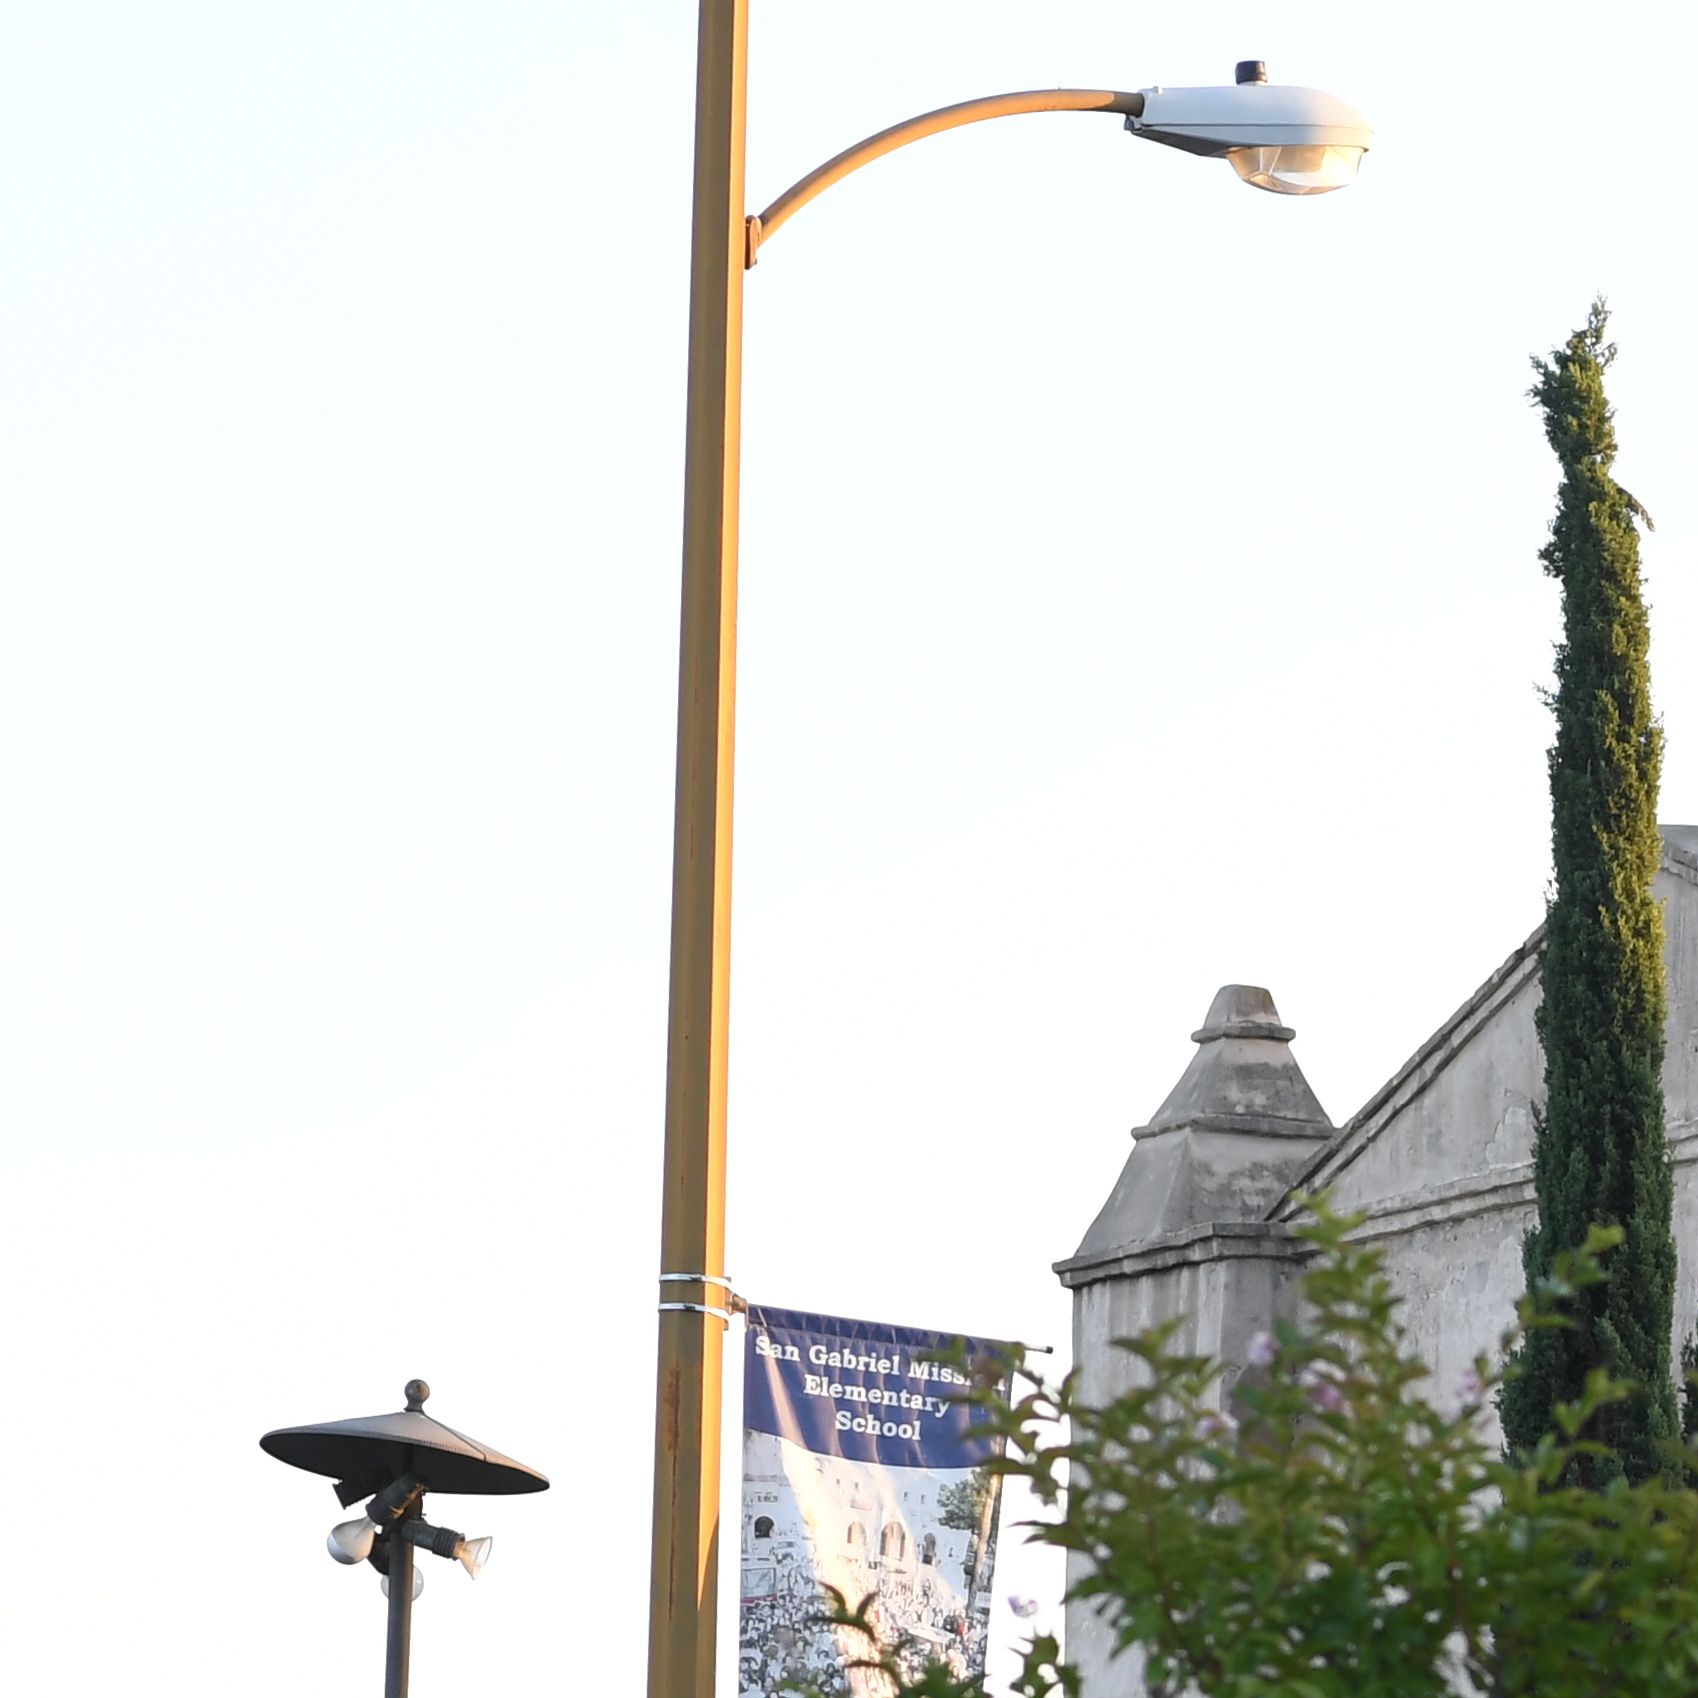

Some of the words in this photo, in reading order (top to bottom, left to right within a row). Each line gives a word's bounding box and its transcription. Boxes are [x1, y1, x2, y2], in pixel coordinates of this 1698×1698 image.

[755, 1335, 800, 1362] San
[809, 1345, 900, 1376] Gabriel
[803, 1374, 950, 1418] Elementary
[835, 1411, 921, 1440] School
